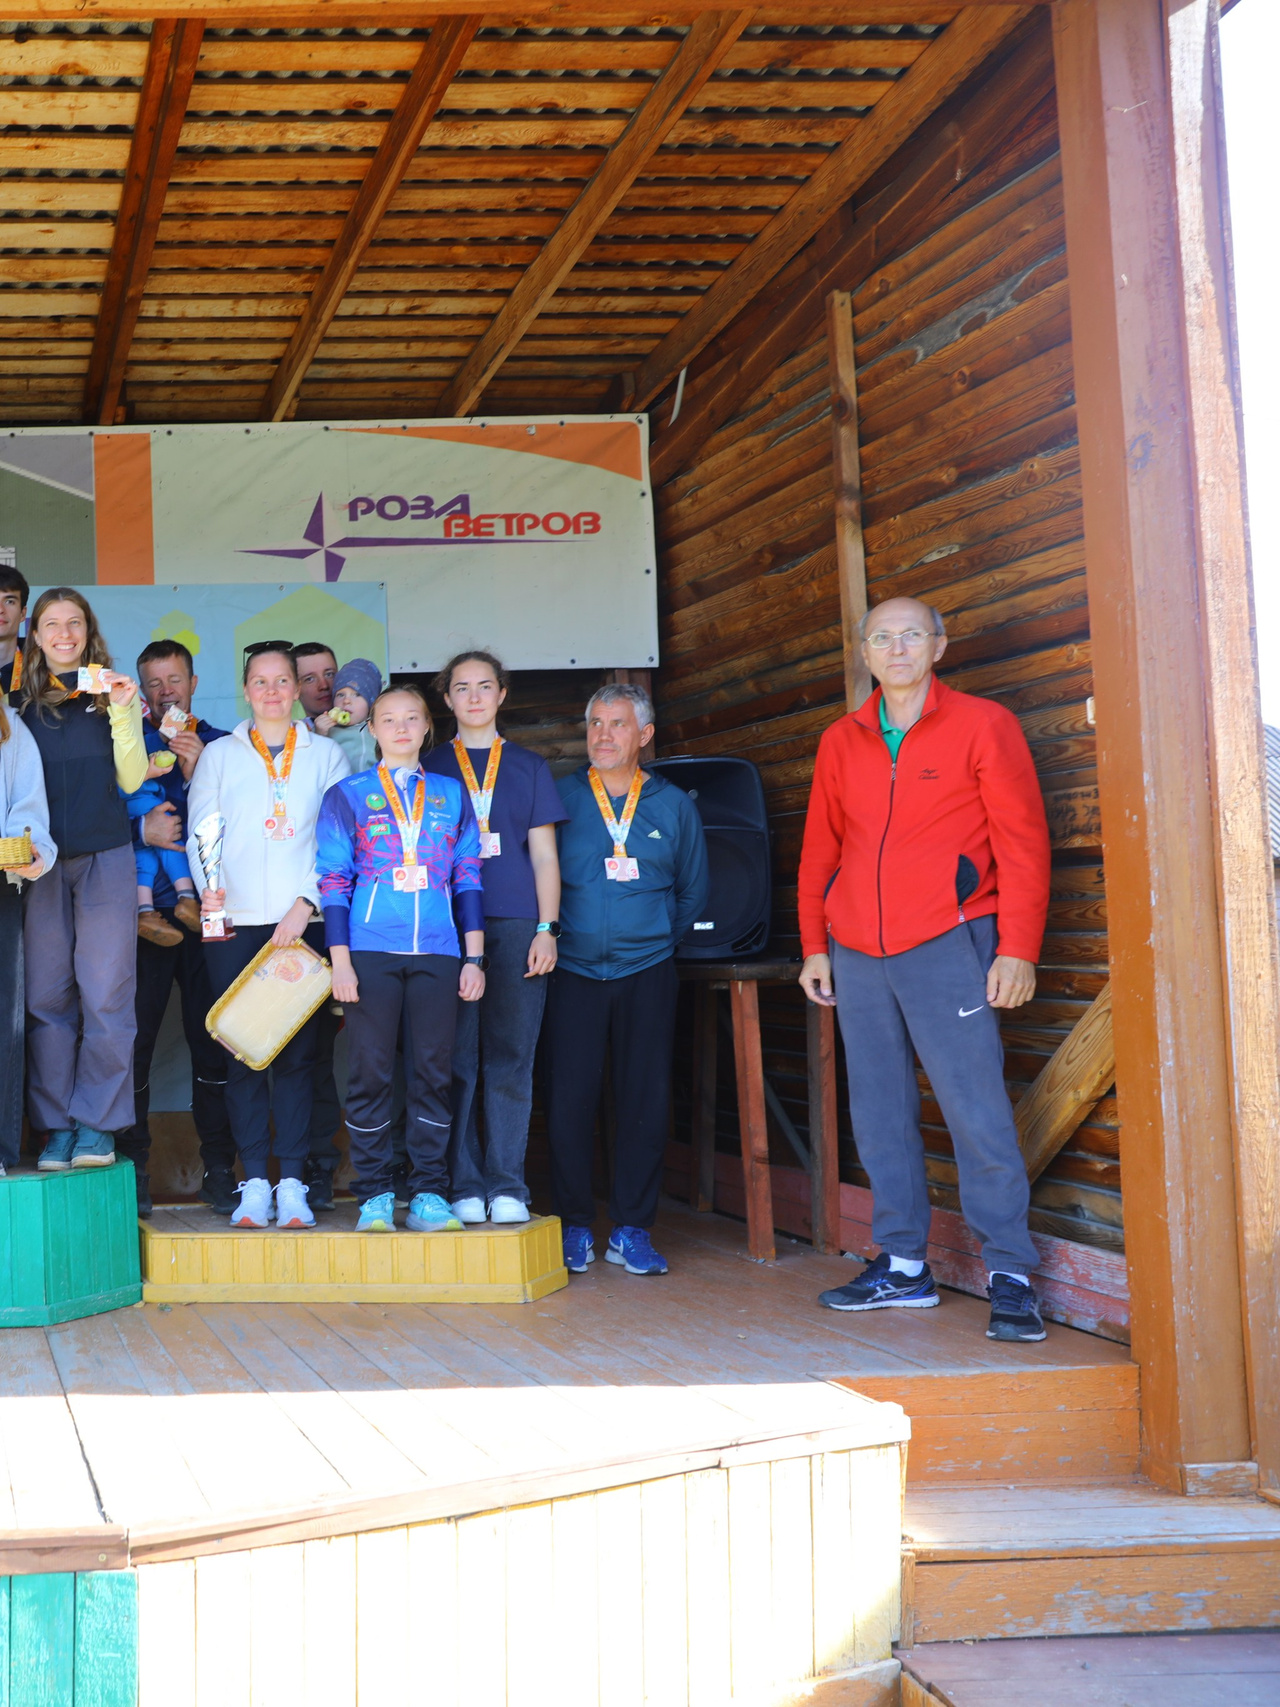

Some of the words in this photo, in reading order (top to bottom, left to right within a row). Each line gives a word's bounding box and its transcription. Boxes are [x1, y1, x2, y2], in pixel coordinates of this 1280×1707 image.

[348, 494, 470, 521] РОЗА
[443, 511, 602, 538] ВЕТРОВ
[287, 828, 294, 837] 3
[491, 844, 499, 854] 3
[630, 868, 638, 877] 3
[419, 878, 427, 887] 3
